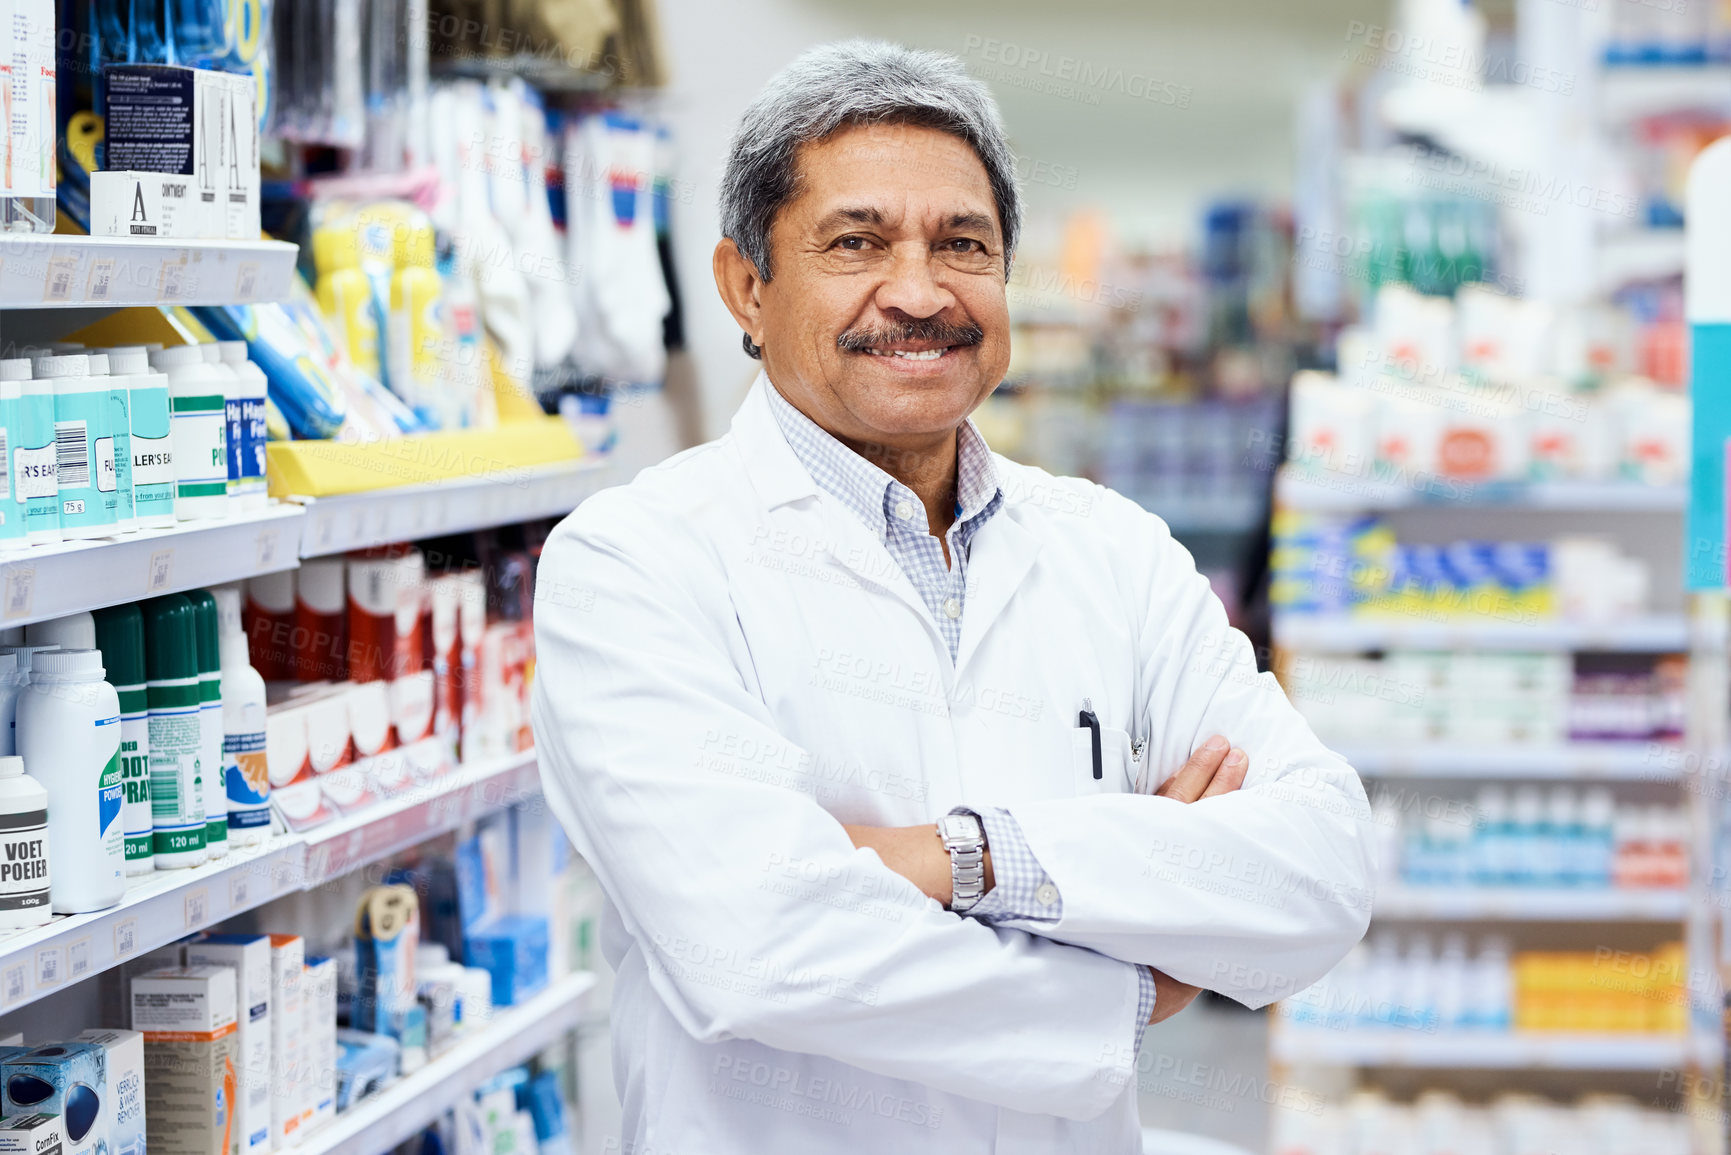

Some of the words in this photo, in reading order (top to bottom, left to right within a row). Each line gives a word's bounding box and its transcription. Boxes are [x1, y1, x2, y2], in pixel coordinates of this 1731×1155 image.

[130, 181, 147, 221] A
[65, 503, 76, 512] 75
[5, 839, 43, 861] VOET
[170, 836, 187, 848] 120
[189, 834, 199, 846] ml
[1, 859, 47, 882] POEIER
